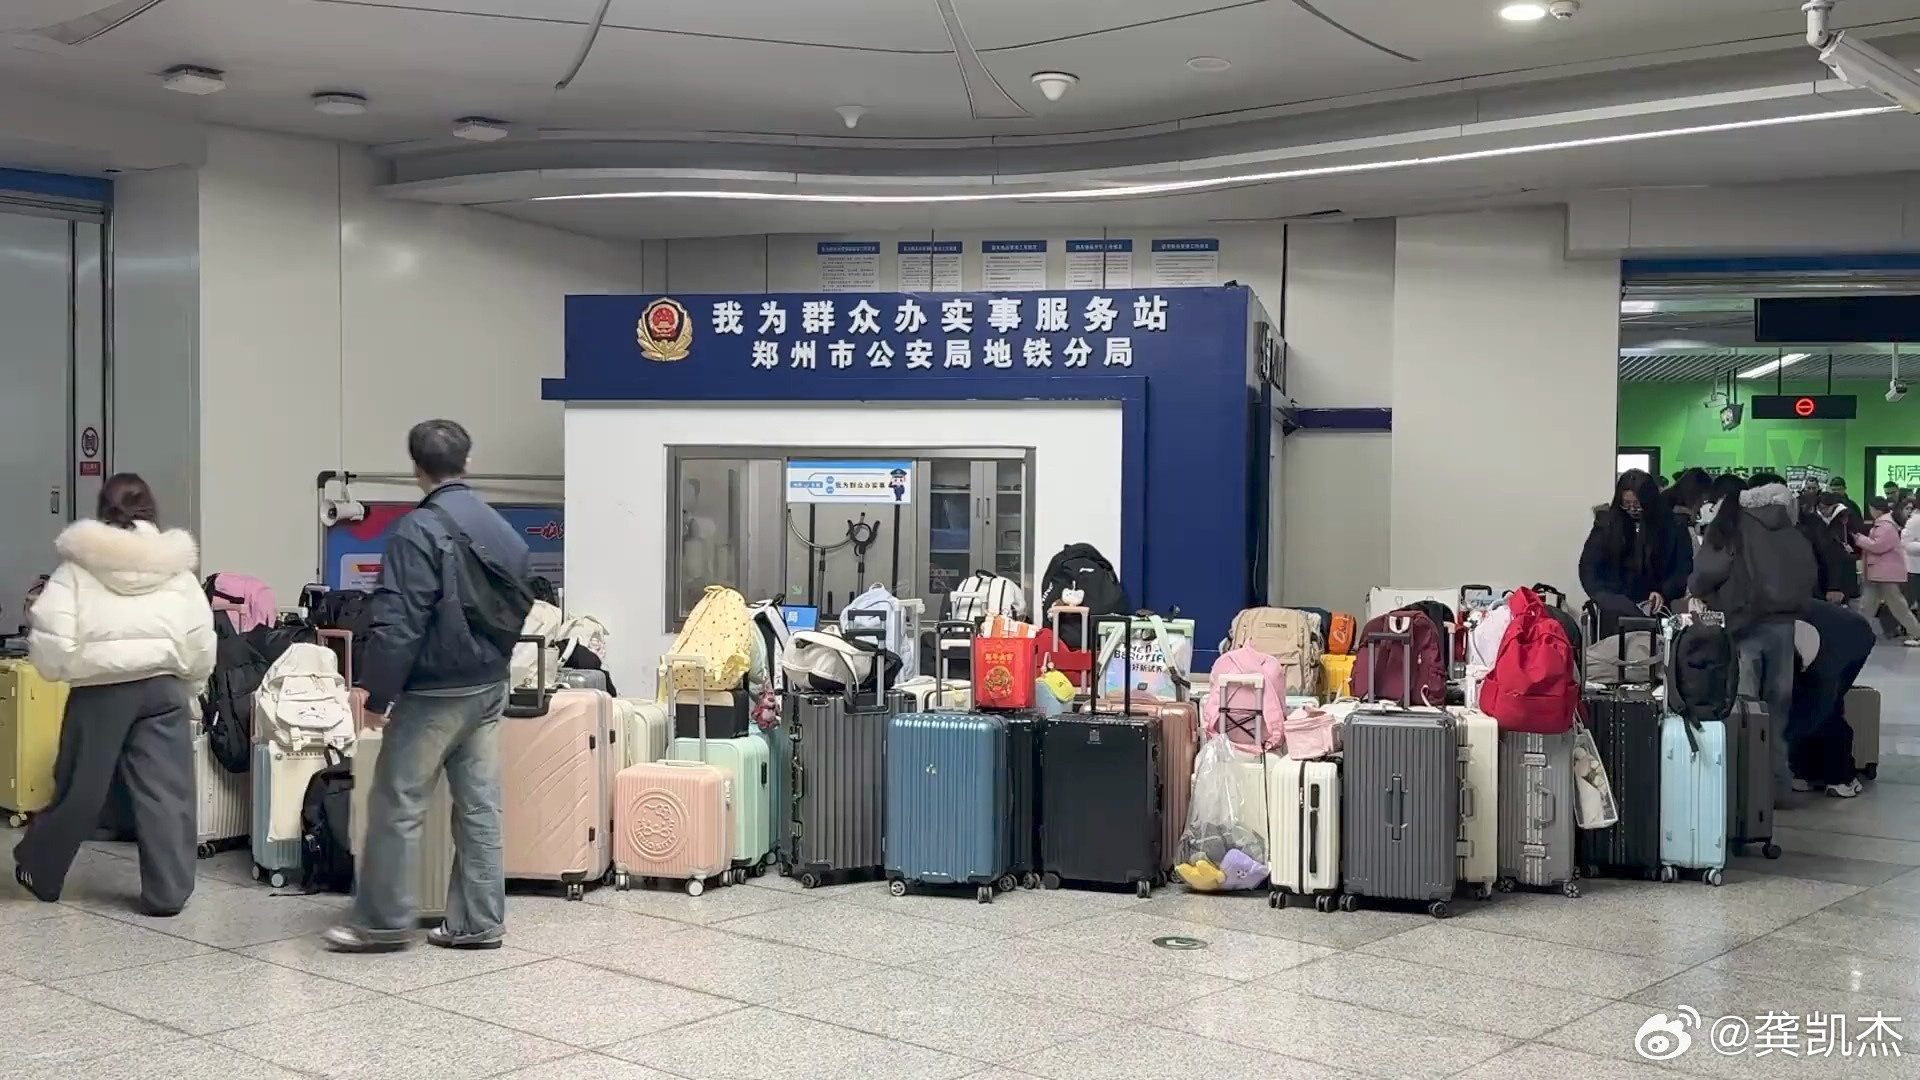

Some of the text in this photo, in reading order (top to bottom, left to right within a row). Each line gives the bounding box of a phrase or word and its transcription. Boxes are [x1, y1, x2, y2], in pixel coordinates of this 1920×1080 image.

[712, 295, 1168, 335] 我为群众办实事服务站
[752, 336, 1133, 369] 郑州市公安局地铁分局
